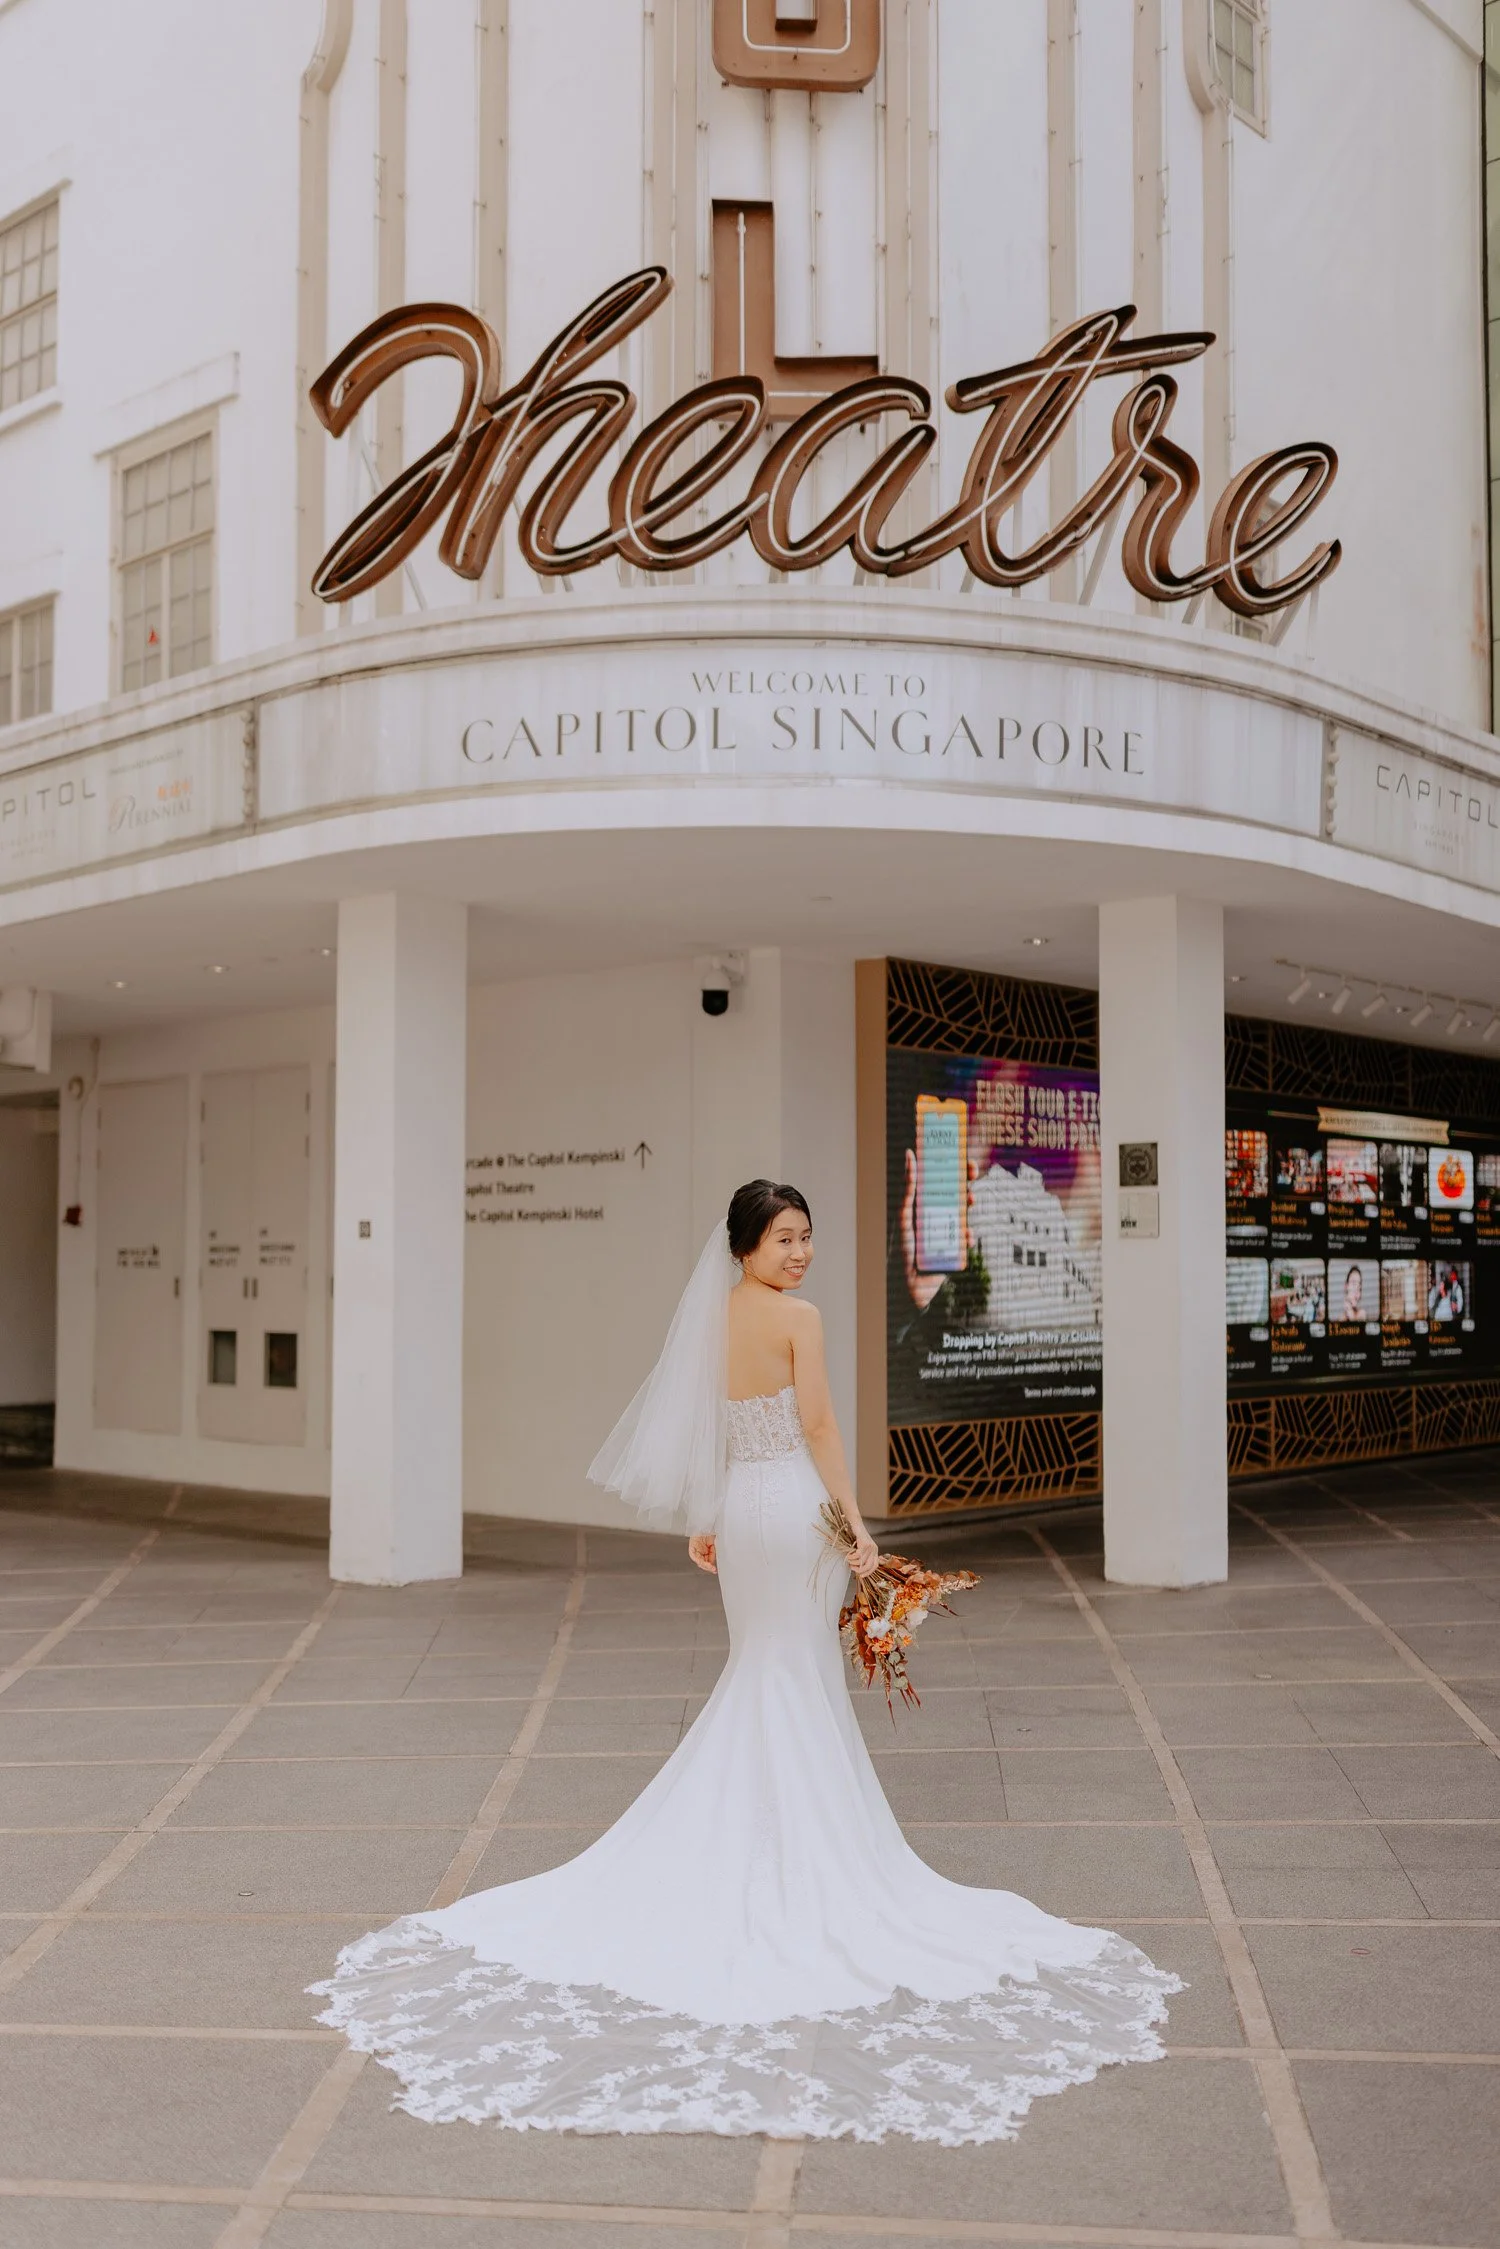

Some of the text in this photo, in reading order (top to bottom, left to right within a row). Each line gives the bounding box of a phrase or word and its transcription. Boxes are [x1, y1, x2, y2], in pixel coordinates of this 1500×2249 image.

[310, 265, 1342, 617] Theatre
[691, 670, 926, 699] WELCOME TO
[461, 704, 1144, 775] CAPITOL SINGAPORE
[1, 777, 97, 823] PITOL
[1376, 764, 1499, 829] CAPITOL
[976, 1079, 1025, 1115] FLASH
[1028, 1085, 1065, 1120] YOUR
[976, 1112, 1024, 1147] THESE
[1028, 1116, 1066, 1151] SHOW
[508, 1153, 525, 1168] The
[527, 1151, 565, 1169] Capitol
[567, 1148, 626, 1166] Kempinski
[466, 1182, 535, 1198] apitol Theatre
[479, 1208, 514, 1224] Capitol
[517, 1207, 572, 1224] Kempinski
[574, 1206, 604, 1220] Hotel
[943, 1332, 984, 1350] Dropping
[985, 1332, 997, 1349] by
[997, 1331, 1028, 1348] Capitol
[1028, 1330, 1059, 1345] Theatre
